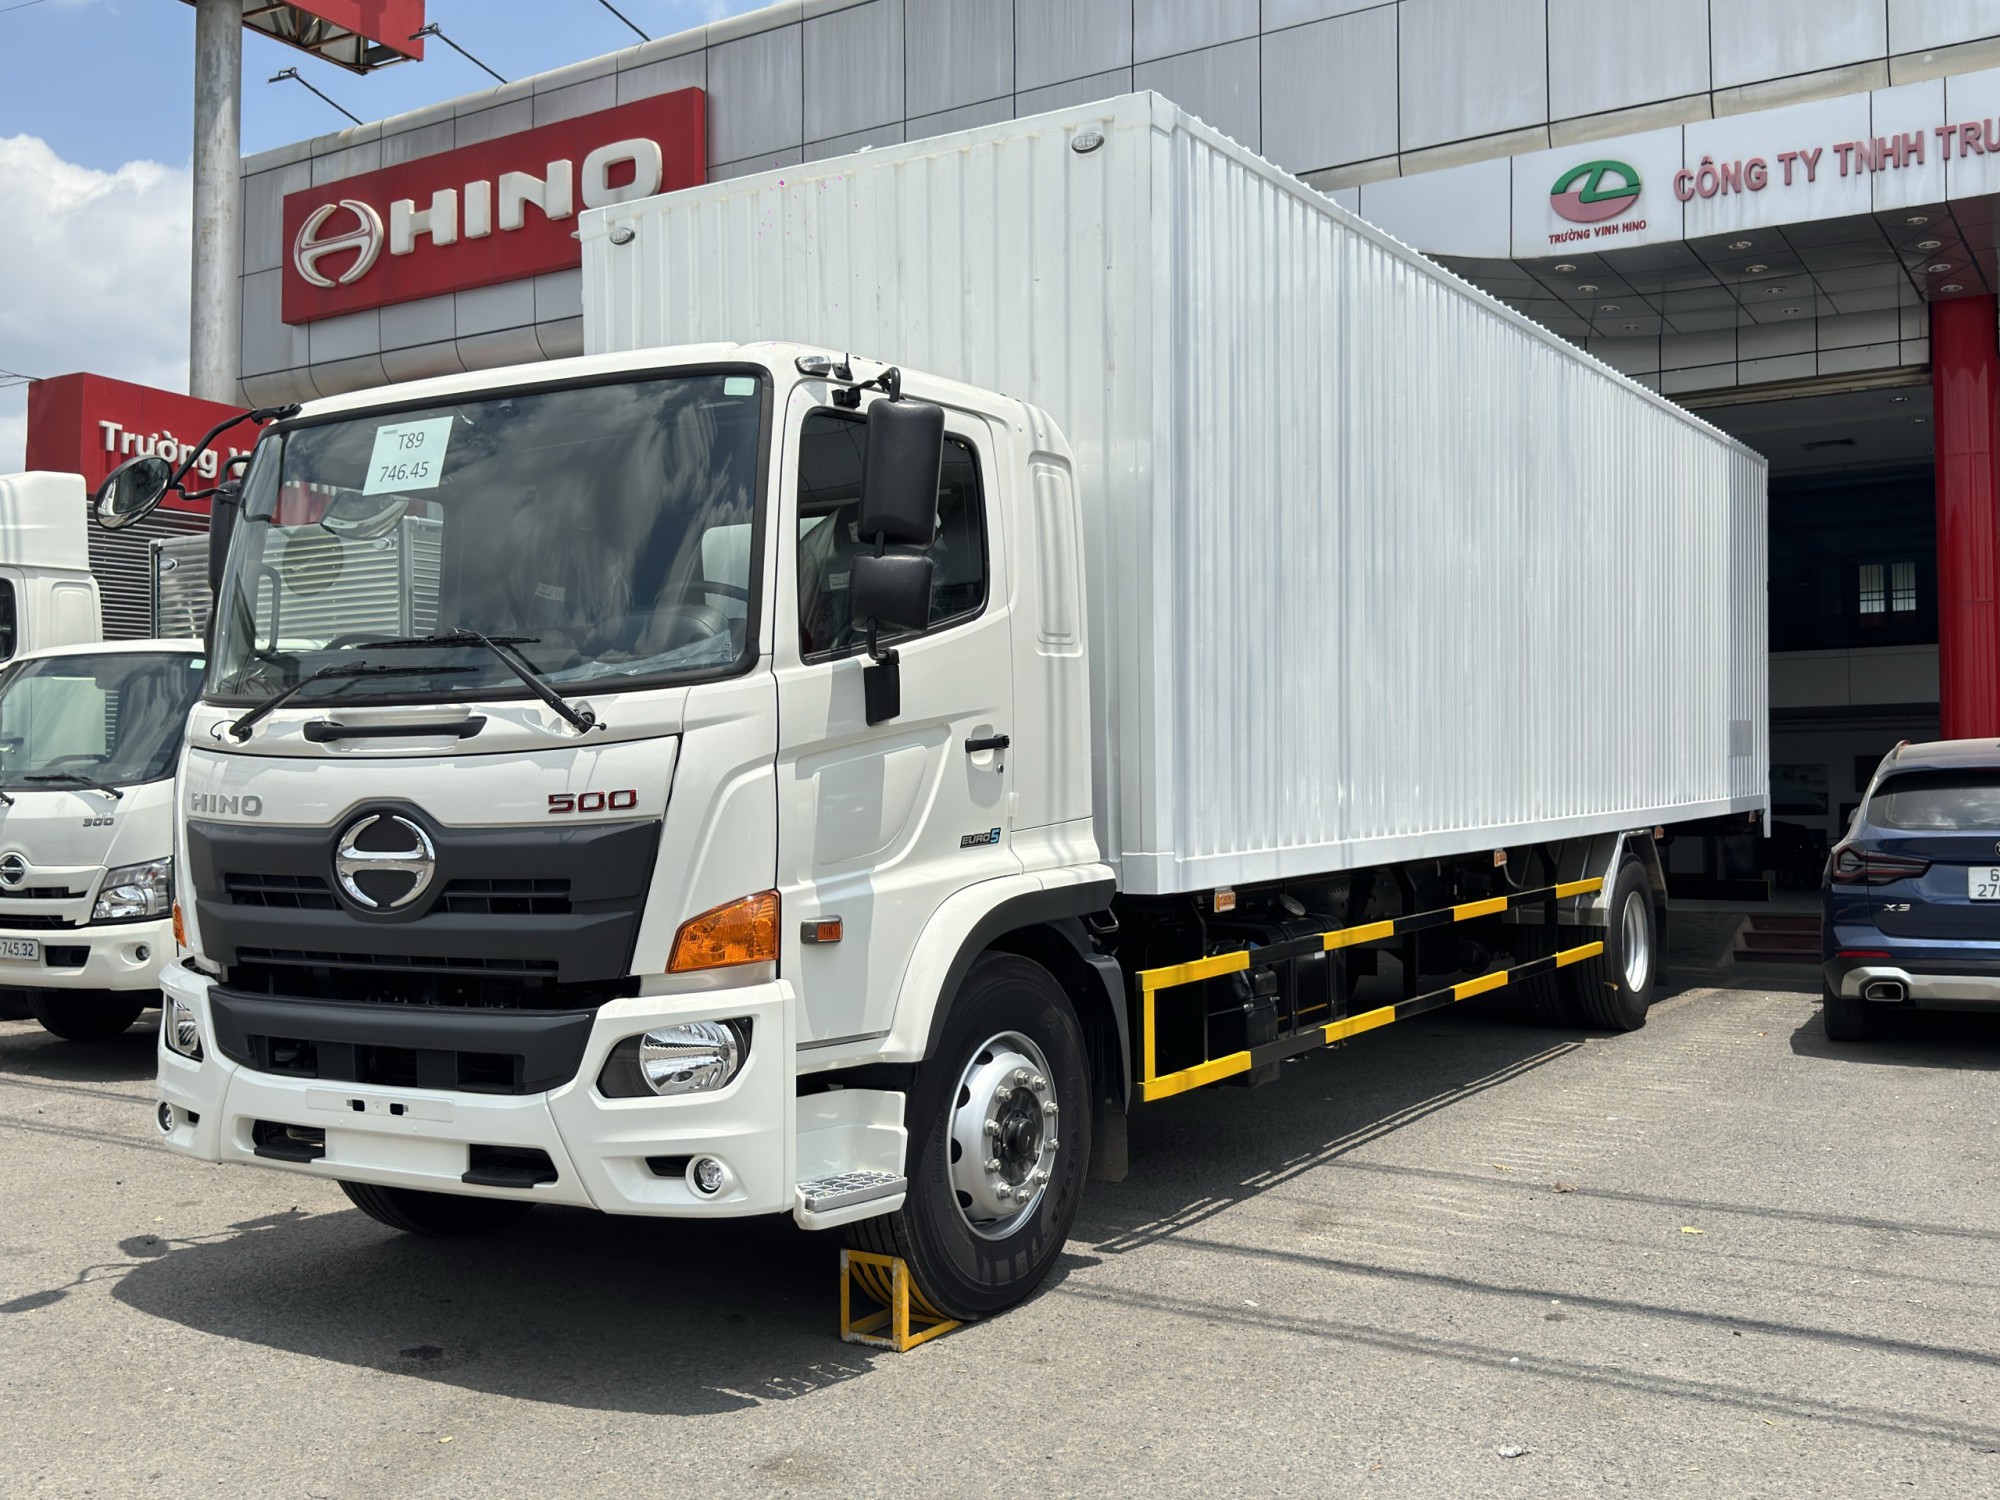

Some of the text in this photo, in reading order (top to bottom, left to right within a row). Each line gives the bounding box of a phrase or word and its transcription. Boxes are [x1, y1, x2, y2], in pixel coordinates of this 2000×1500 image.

[1673, 155, 1767, 201] CÔNG
[1778, 147, 1822, 185] TY
[1833, 130, 1924, 176] TNHH
[391, 138, 662, 255] HINO
[1548, 220, 1647, 245] TRƯỜNG VINH HINO
[99, 420, 218, 479] Trường
[399, 432, 425, 450] T89
[379, 461, 429, 482] 746.45
[191, 792, 263, 816] HINO
[548, 788, 638, 814] 500
[83, 817, 114, 827] 300
